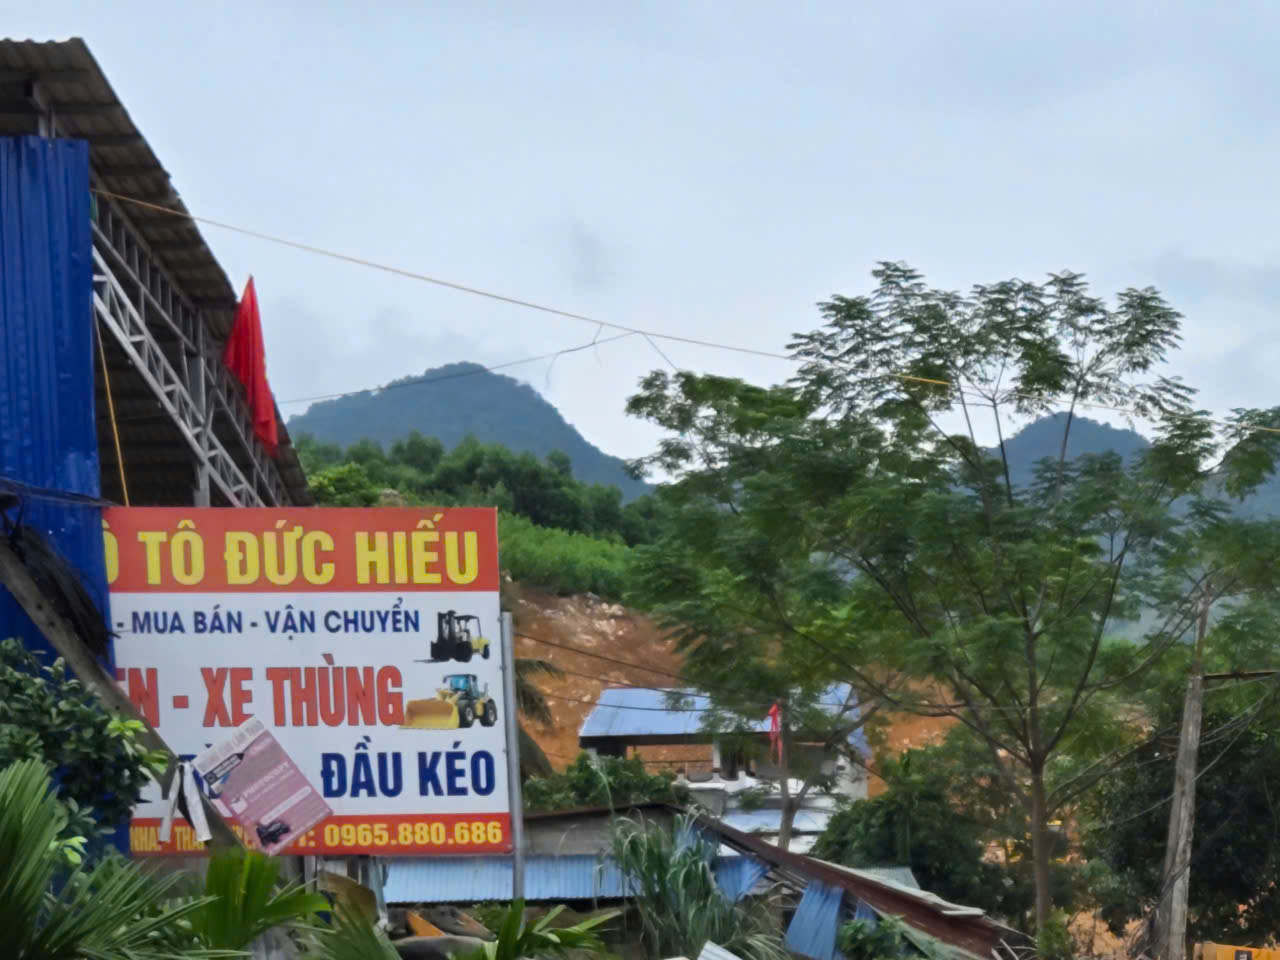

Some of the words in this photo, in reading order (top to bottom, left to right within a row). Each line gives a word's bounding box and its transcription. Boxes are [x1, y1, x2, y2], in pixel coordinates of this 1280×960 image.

[137, 519, 205, 585] TÔ
[224, 519, 335, 585] ĐỨC
[355, 513, 479, 585] HIẾU
[132, 611, 185, 633] MUA
[193, 604, 243, 633] BÁN
[265, 604, 316, 640] VẬN
[324, 597, 420, 633] CHUYỂN
[200, 667, 254, 728] XE
[266, 653, 405, 727] THÙNG
[320, 736, 404, 798] ĐẦU
[417, 741, 496, 797] KÉO
[324, 821, 503, 847] 0965.880.686
